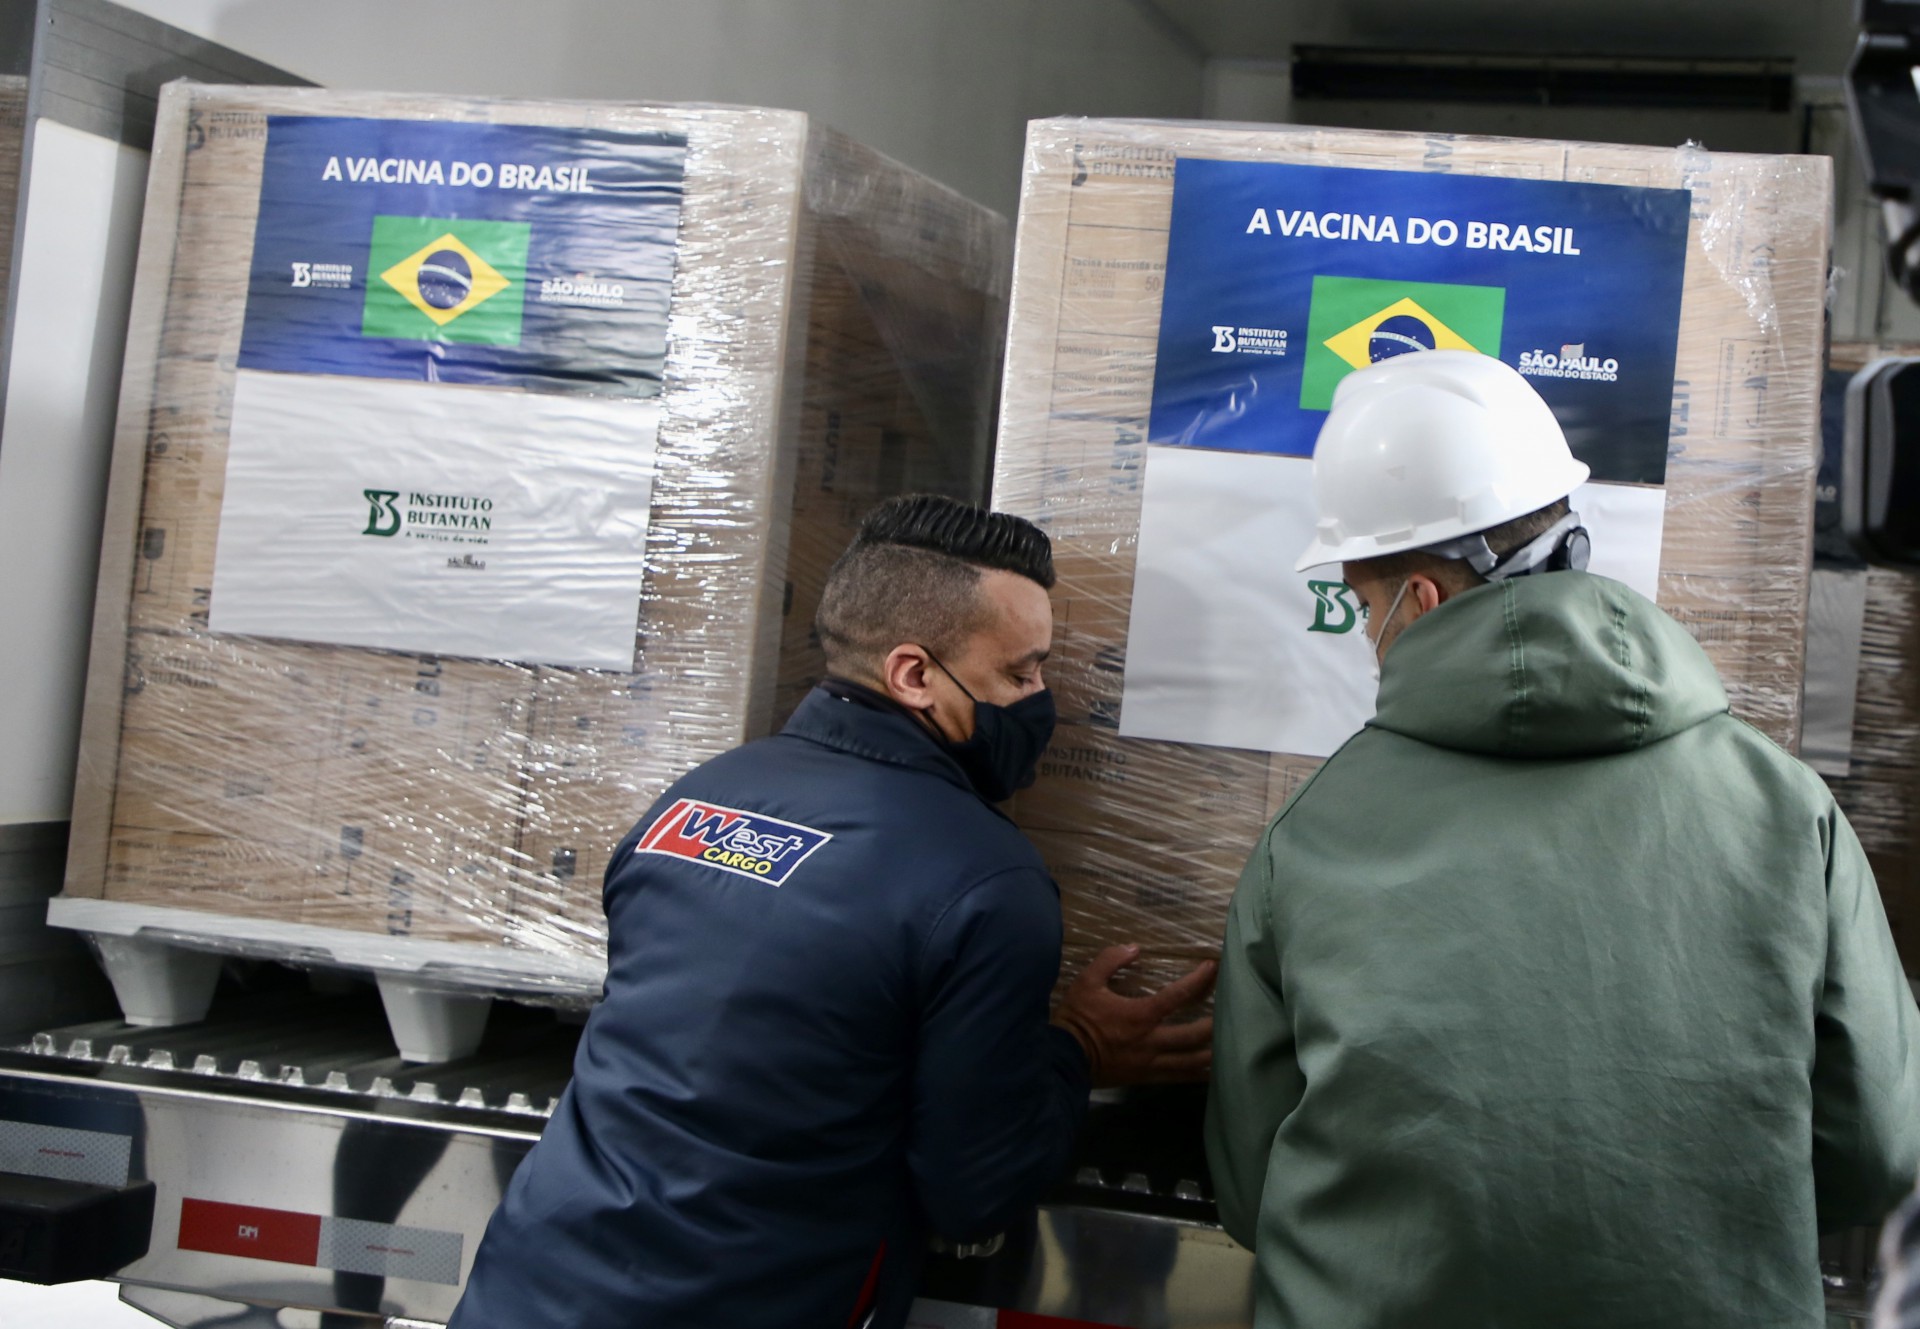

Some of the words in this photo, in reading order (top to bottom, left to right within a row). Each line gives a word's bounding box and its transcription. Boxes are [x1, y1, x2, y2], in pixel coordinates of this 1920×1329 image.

[322, 156, 342, 181] A
[346, 157, 445, 186] VACINA
[450, 161, 493, 188] DO
[498, 163, 593, 192] BRASIL
[1246, 208, 1271, 235] A
[1276, 209, 1400, 243] VACINA
[1406, 217, 1458, 246] DO
[1465, 221, 1580, 255] BRASIL
[541, 277, 573, 294] SÃO
[1237, 337, 1287, 348] BUTANTAN
[1238, 328, 1287, 339] INSTITUTO
[1519, 348, 1558, 369] SÃO
[1558, 356, 1618, 374] PAULO
[1518, 365, 1564, 377] GOVERNO
[1564, 369, 1579, 378] DO
[1580, 371, 1617, 382] ESTADO
[409, 492, 493, 511] INSTITUTO
[407, 510, 491, 530] BUTANTAN
[679, 808, 804, 862] West
[703, 846, 772, 875] CARGO
